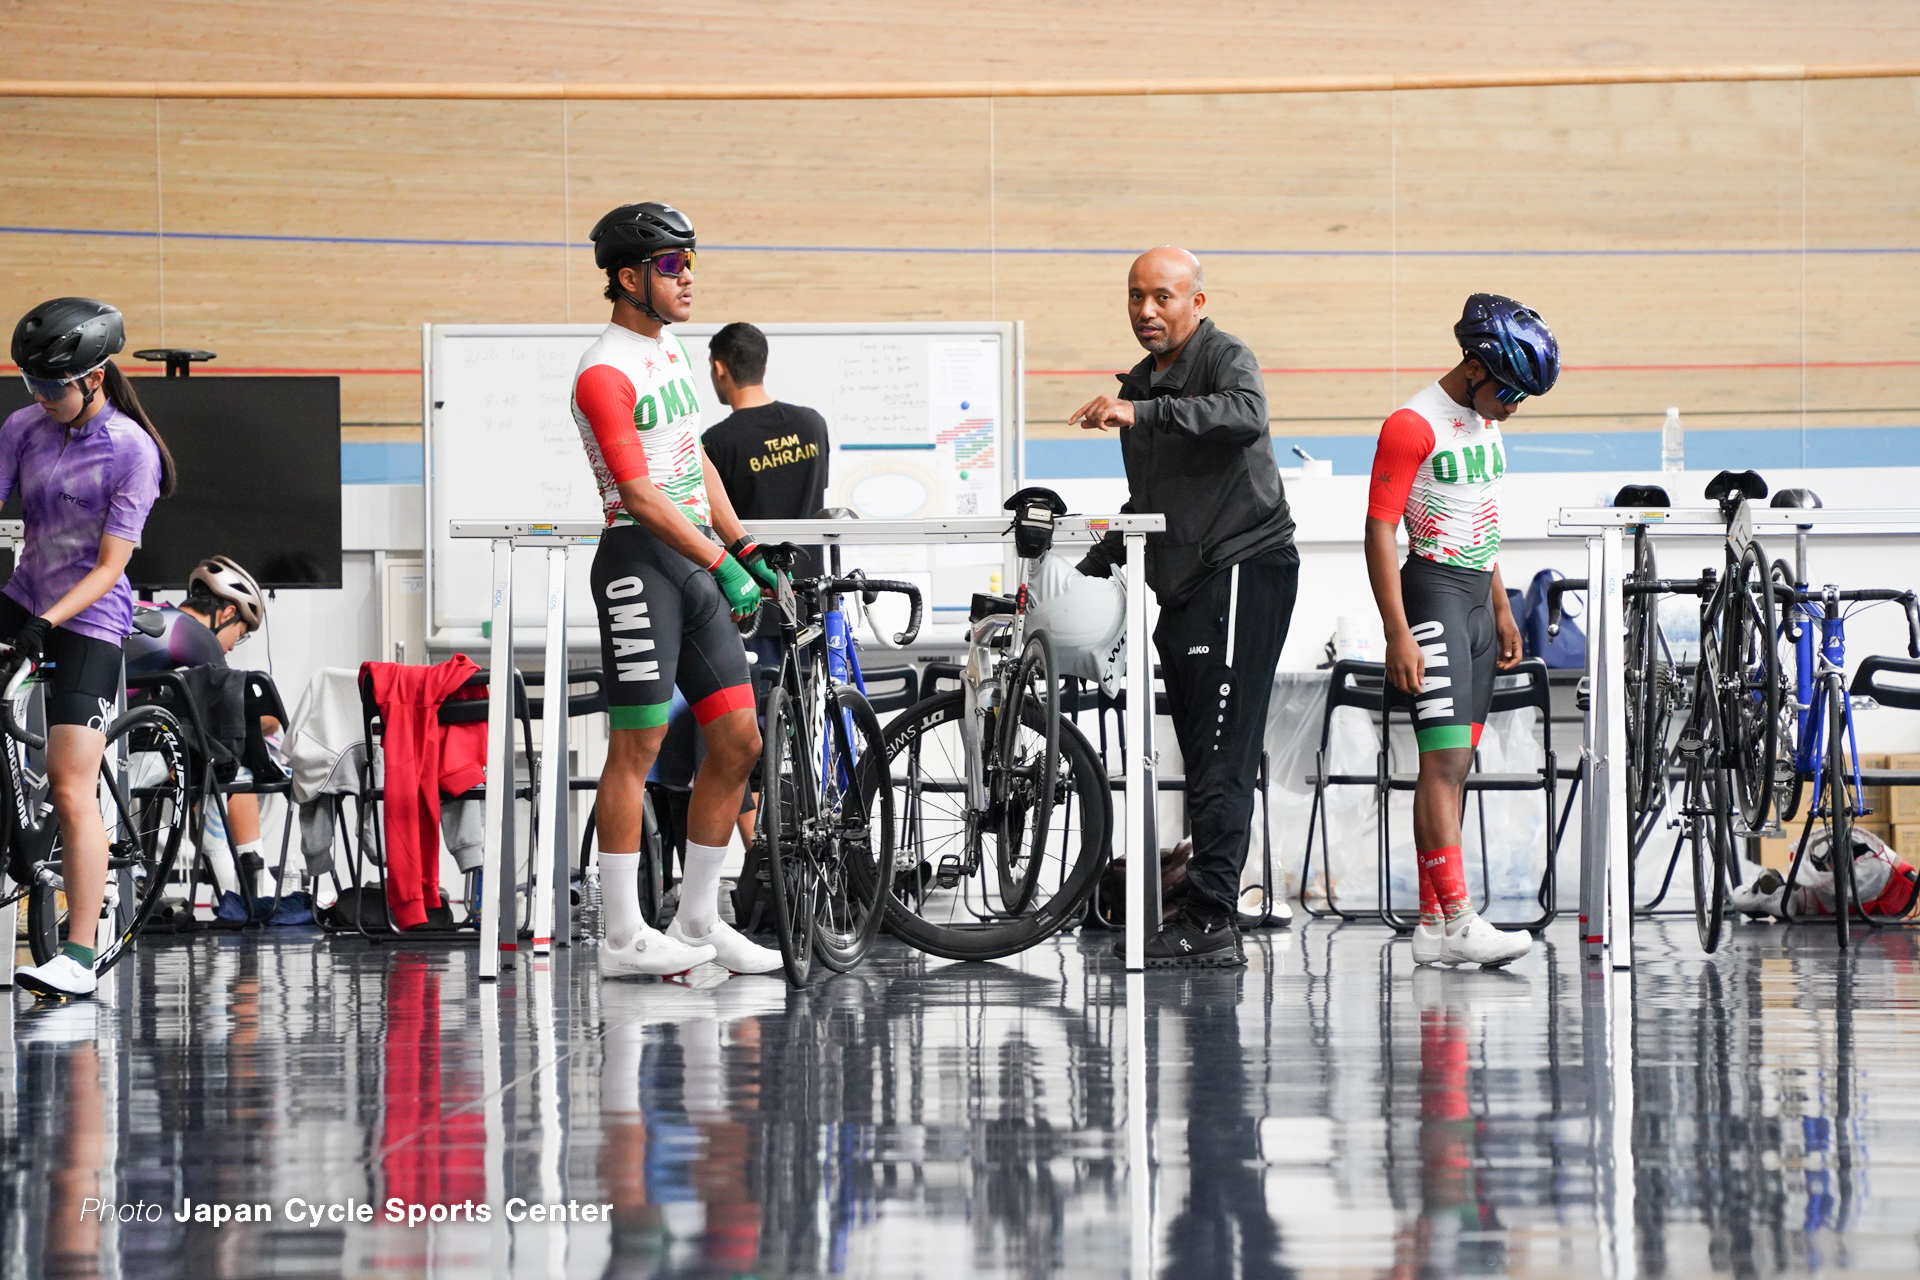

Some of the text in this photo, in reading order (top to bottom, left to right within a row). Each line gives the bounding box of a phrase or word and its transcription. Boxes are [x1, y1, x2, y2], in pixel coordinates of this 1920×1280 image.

[465, 346, 498, 363] 2026
[484, 392, 518, 407] 8:45
[634, 376, 700, 431] OMA
[484, 418, 514, 432] 9:00
[764, 433, 800, 452] TEAM
[749, 443, 820, 472] BAHRAIN
[1432, 442, 1506, 484] OMA
[605, 575, 660, 682] OMAN
[1187, 645, 1210, 656] JAKO
[1409, 620, 1455, 721] OMAN
[885, 709, 945, 760] DT SWIS
[163, 731, 185, 829] ELLIPSE
